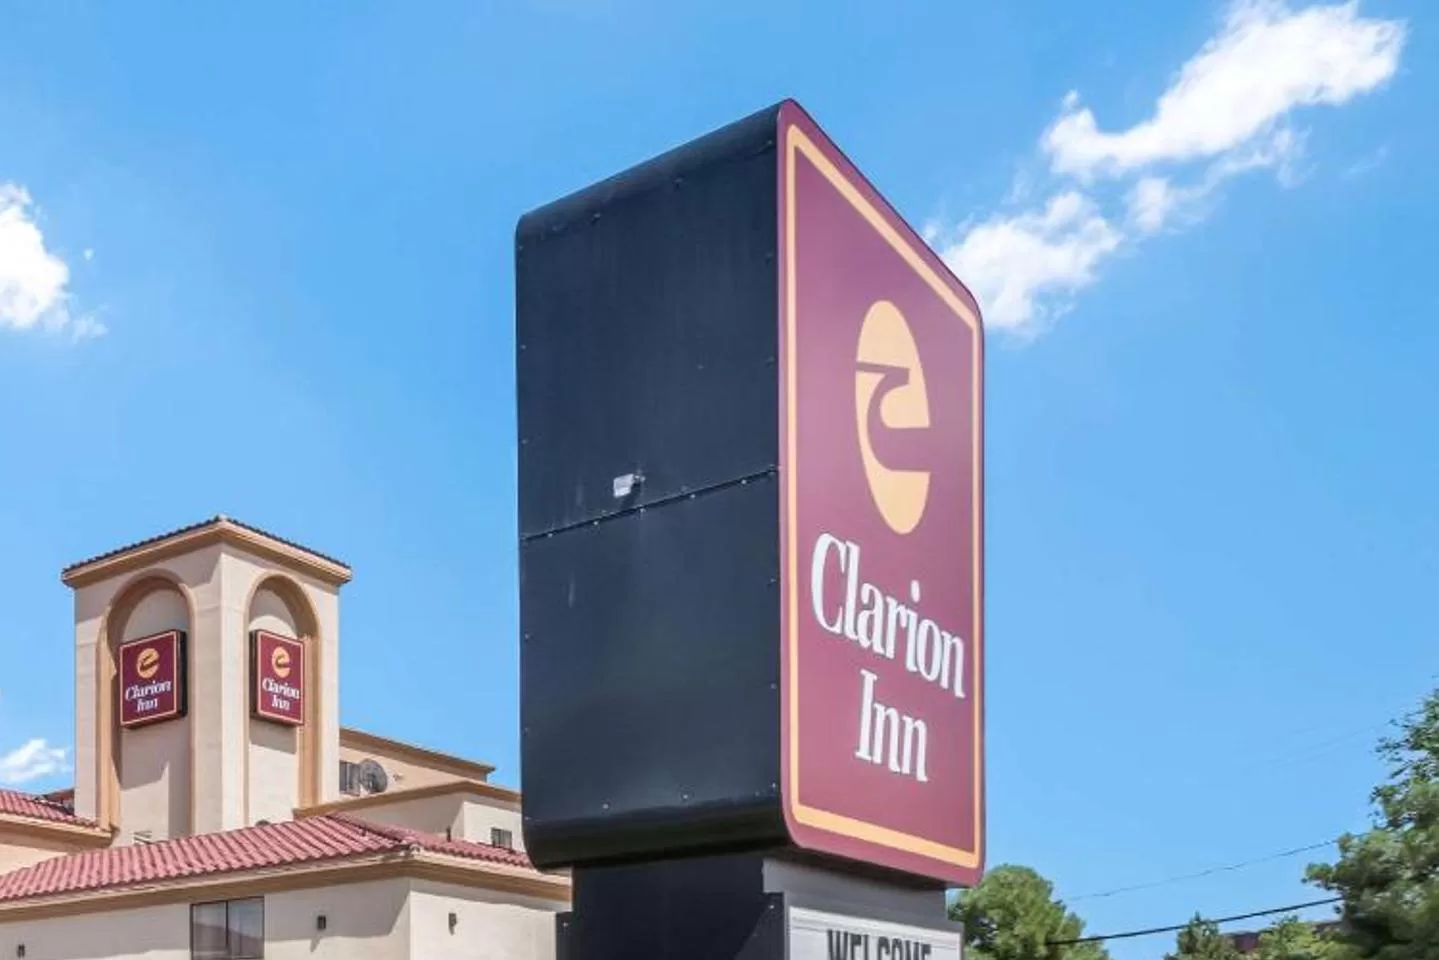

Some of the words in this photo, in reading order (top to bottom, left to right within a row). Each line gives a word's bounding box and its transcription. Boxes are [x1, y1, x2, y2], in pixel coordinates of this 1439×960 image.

[811, 532, 965, 698] Clarion
[125, 680, 171, 700] Clarion
[262, 677, 299, 699] Clarion
[855, 669, 928, 782] Inn
